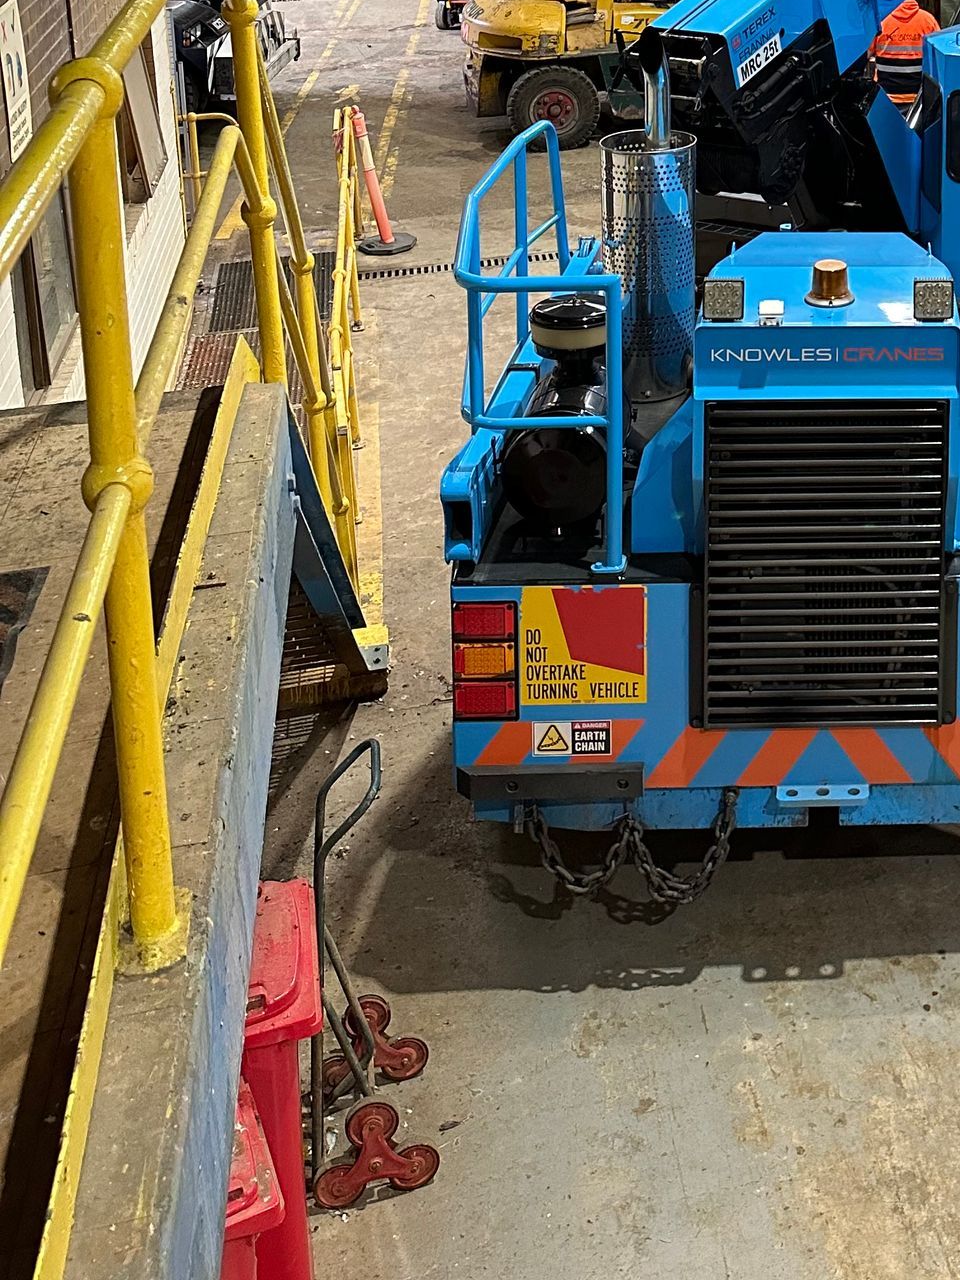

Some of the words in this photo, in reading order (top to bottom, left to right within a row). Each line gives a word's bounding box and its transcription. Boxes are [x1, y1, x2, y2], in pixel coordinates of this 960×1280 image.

[742, 6, 777, 39] TEREX
[738, 27, 776, 64] FRANNA
[740, 53, 762, 81] MRC
[711, 348, 832, 362] KNOWLES
[843, 347, 944, 362] CRANES
[526, 629, 541, 645] DO
[526, 647, 548, 663] NOT
[526, 664, 586, 681] OVERTAKE
[526, 683, 578, 699] TURNING
[590, 682, 639, 698] VEHICLE
[574, 731, 606, 741] EARTH
[574, 741, 605, 751] CHAIN
